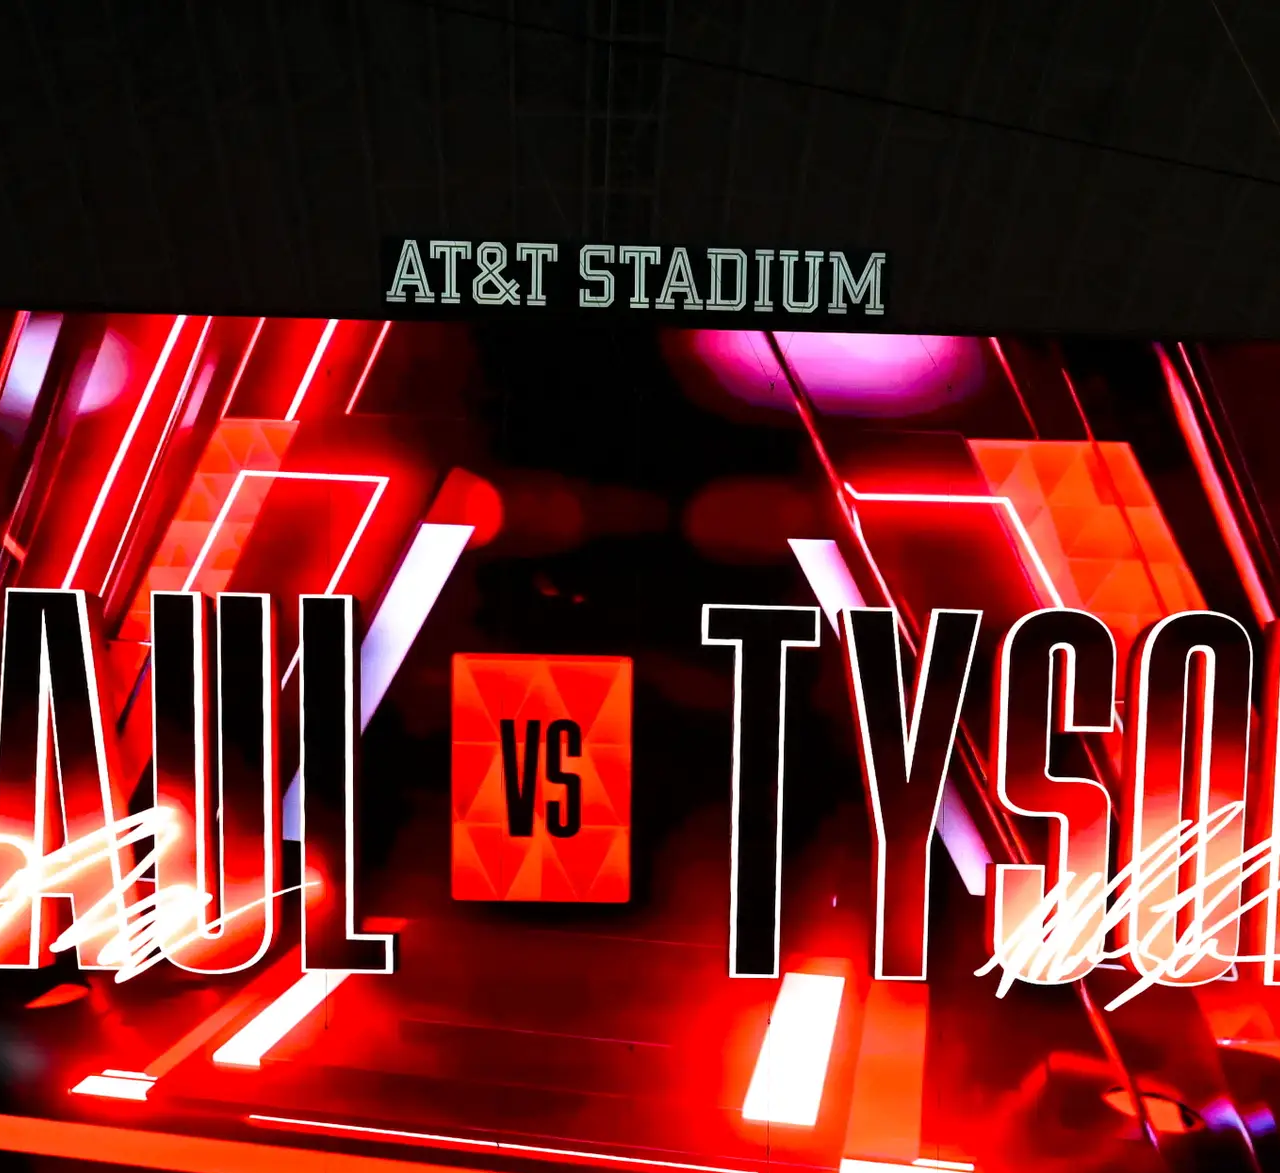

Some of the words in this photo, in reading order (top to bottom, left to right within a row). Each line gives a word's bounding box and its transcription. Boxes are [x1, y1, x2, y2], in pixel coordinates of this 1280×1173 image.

[386, 240, 558, 306] AT&T
[580, 244, 886, 315] STADIUM
[502, 717, 585, 840] VS
